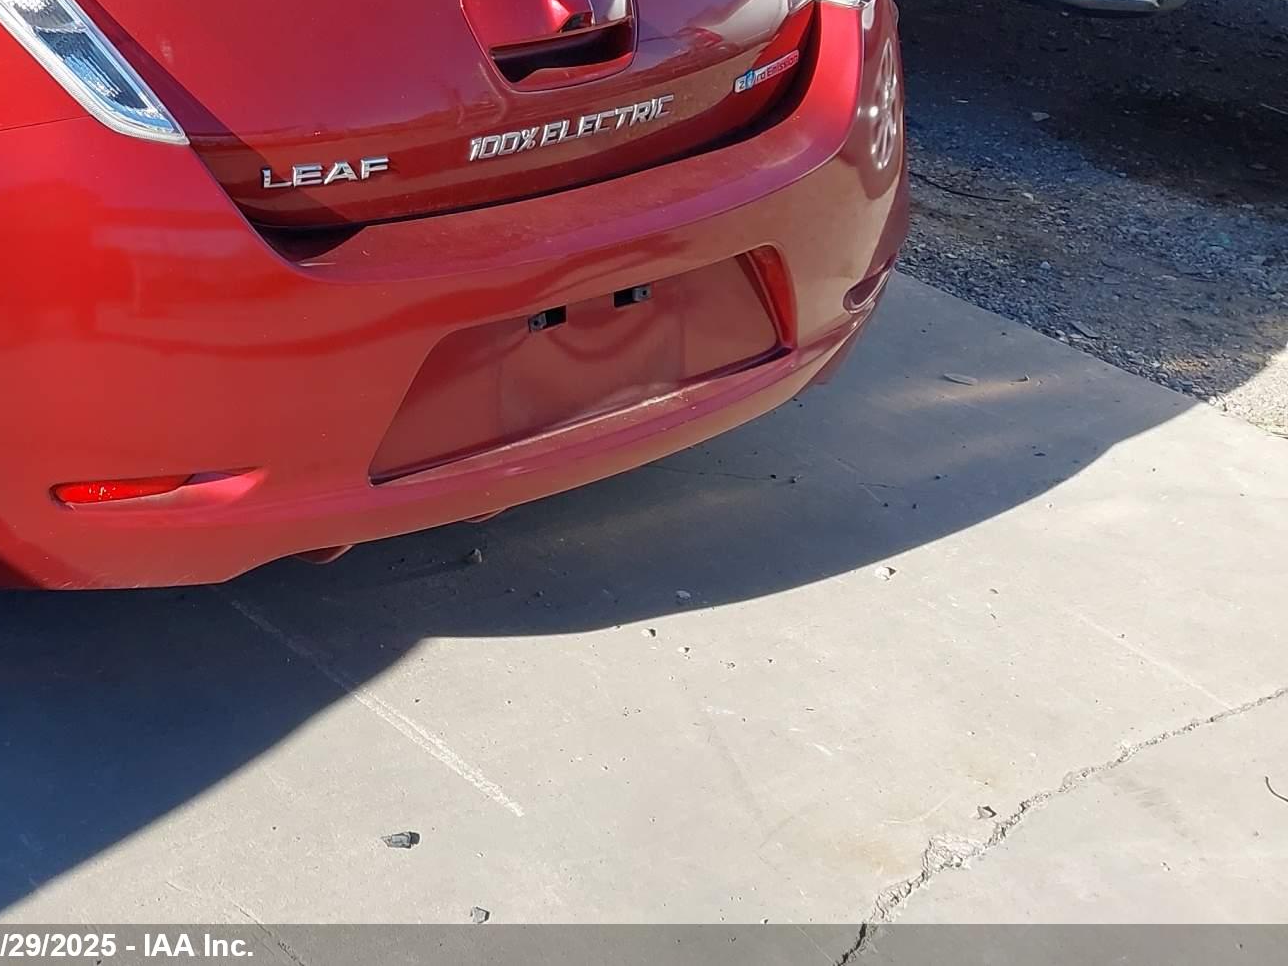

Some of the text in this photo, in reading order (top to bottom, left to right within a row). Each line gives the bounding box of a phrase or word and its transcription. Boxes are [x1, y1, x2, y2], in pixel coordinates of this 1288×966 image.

[469, 95, 674, 162] 100% ELECTRIC
[261, 155, 389, 189] LEAF
